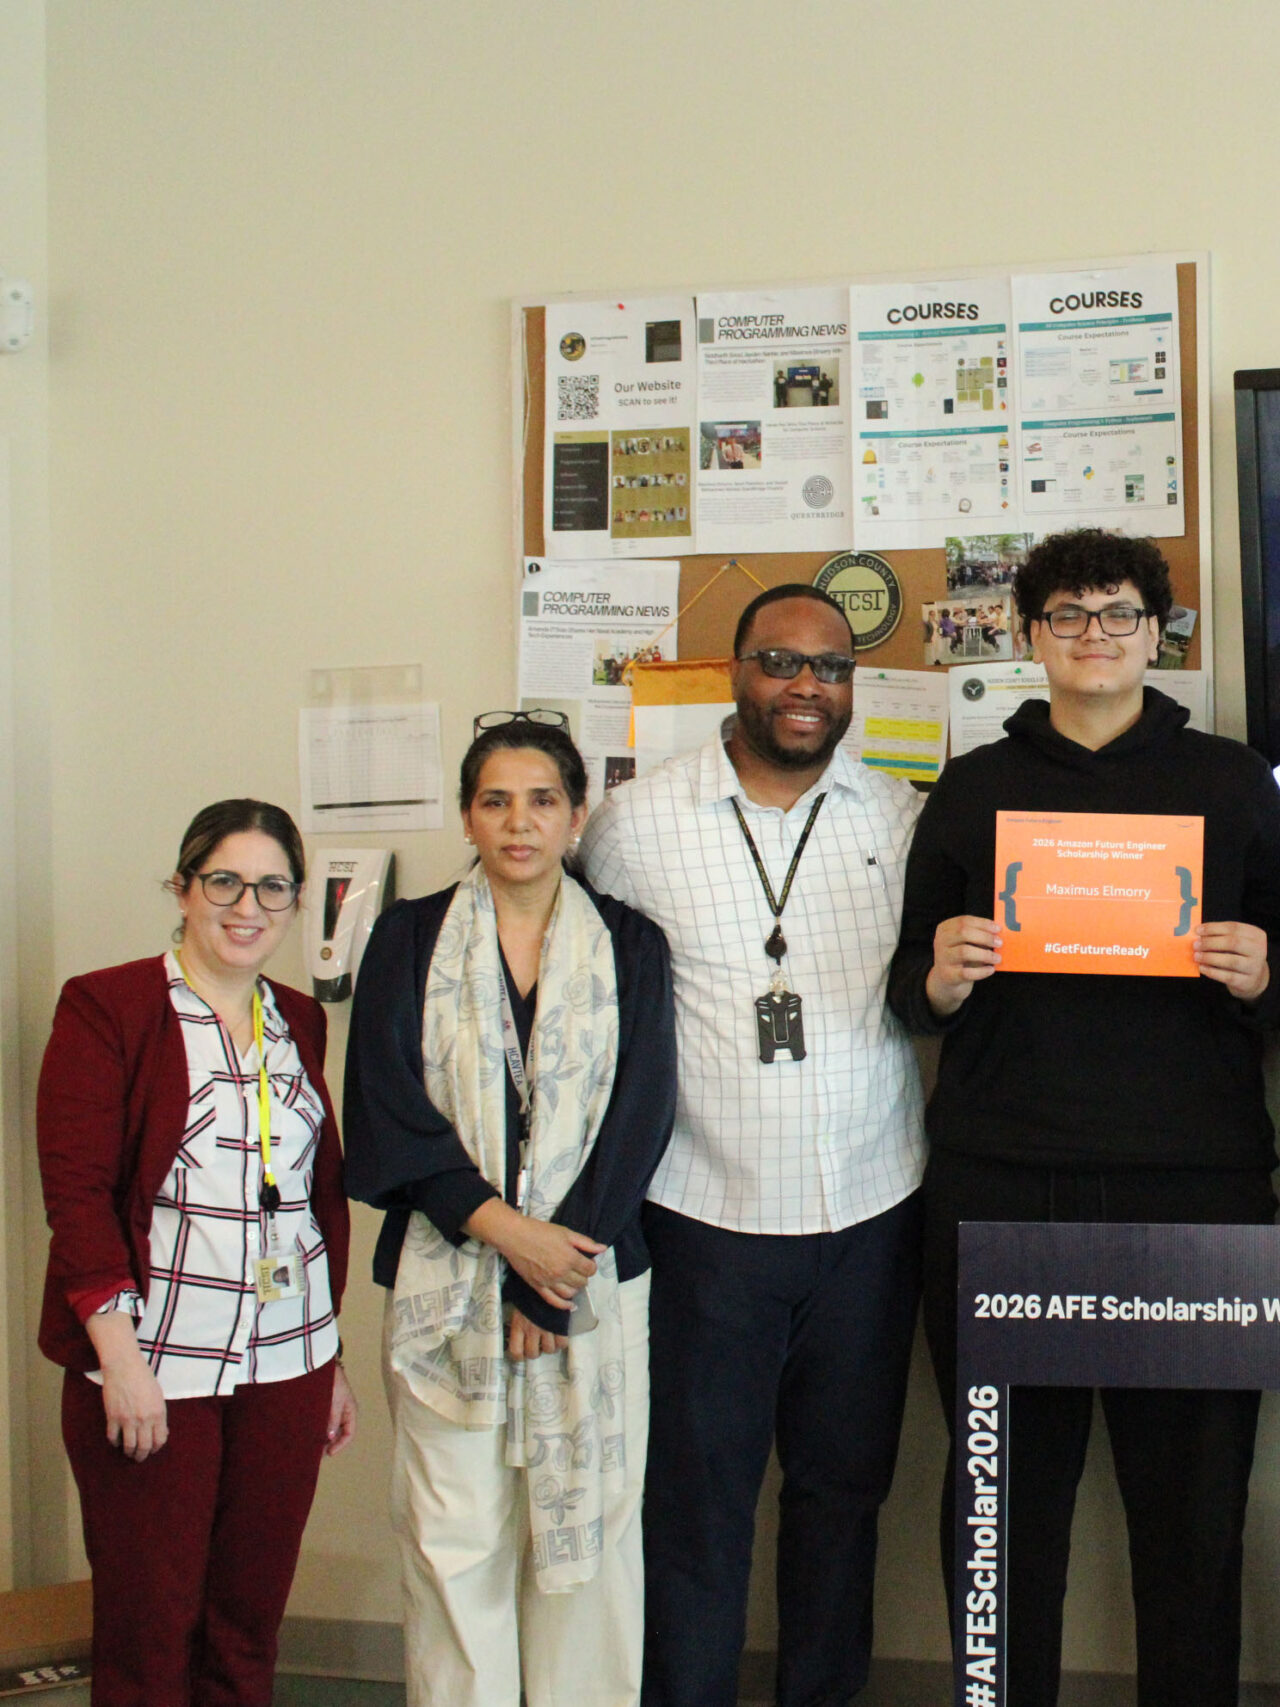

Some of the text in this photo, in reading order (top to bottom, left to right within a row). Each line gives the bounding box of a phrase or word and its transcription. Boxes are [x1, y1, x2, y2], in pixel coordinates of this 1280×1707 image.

[1050, 291, 1143, 314] COURSES
[887, 302, 979, 324] COURSES
[718, 314, 785, 328] COMPUTER
[718, 325, 809, 340] PROGRAMMING
[811, 323, 847, 336] NEWS
[1057, 333, 1082, 341] Course
[614, 380, 682, 393] Our Website
[618, 396, 678, 407] SCAN to see it!
[1062, 431, 1088, 439] Course
[818, 556, 897, 591] HUDSON COUNTY
[543, 591, 611, 604] COMPUTER
[542, 603, 670, 617] PROGRAMMING NEWS
[1032, 838, 1167, 851] 2026 Amazon Future Engineer
[1057, 849, 1144, 860] Scholarship Winner
[1046, 884, 1151, 900] Maximus Elmorry
[1044, 943, 1150, 958] #GetFutureReady
[974, 1293, 1042, 1320] 2026
[1046, 1294, 1097, 1320] AFE
[1101, 1295, 1258, 1327] Scholarship
[965, 1385, 999, 1707] #AFEScholar2026
